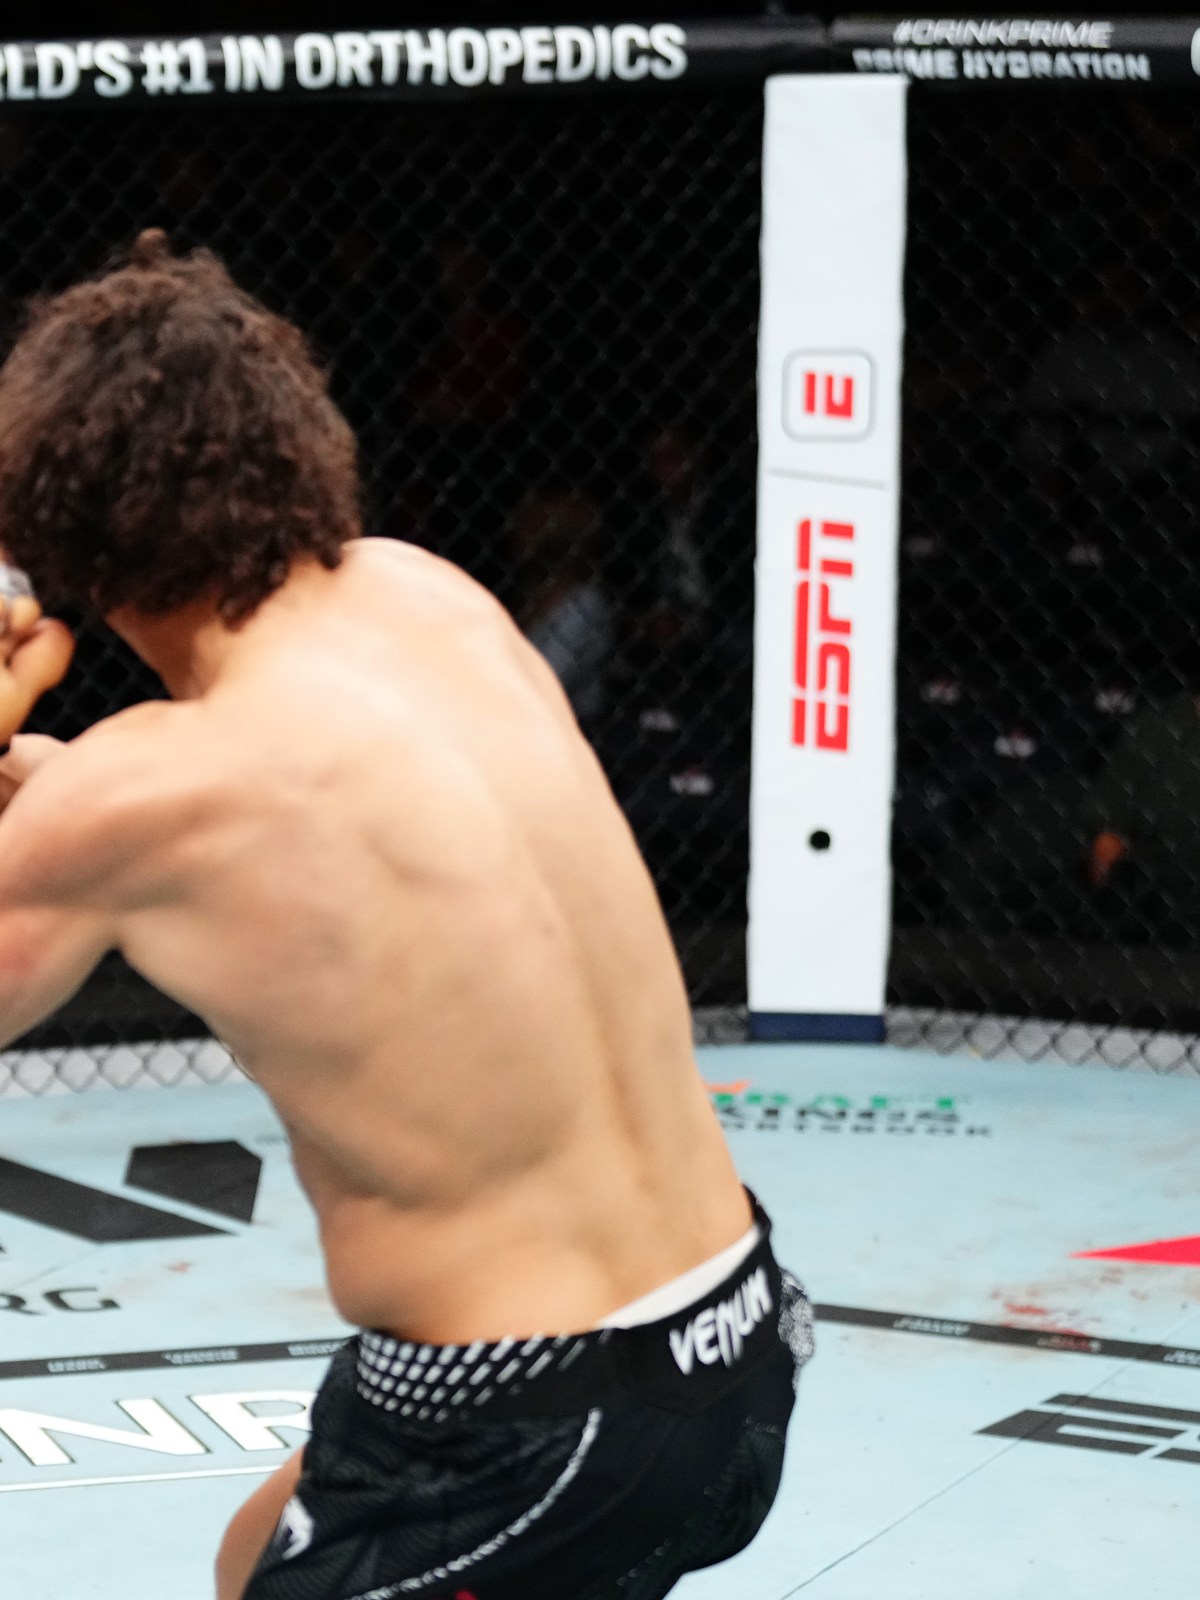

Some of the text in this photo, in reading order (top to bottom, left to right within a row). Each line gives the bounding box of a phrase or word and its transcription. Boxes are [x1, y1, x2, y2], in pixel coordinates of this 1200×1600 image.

[140, 36, 214, 95] #1
[221, 34, 284, 92] IN
[294, 23, 689, 90] ORTHOPEDICS
[893, 19, 1114, 48] #DRINKPRIME
[962, 50, 1151, 81] HYDRATION
[791, 517, 855, 752] ESPN
[668, 1264, 774, 1376] VENUM
